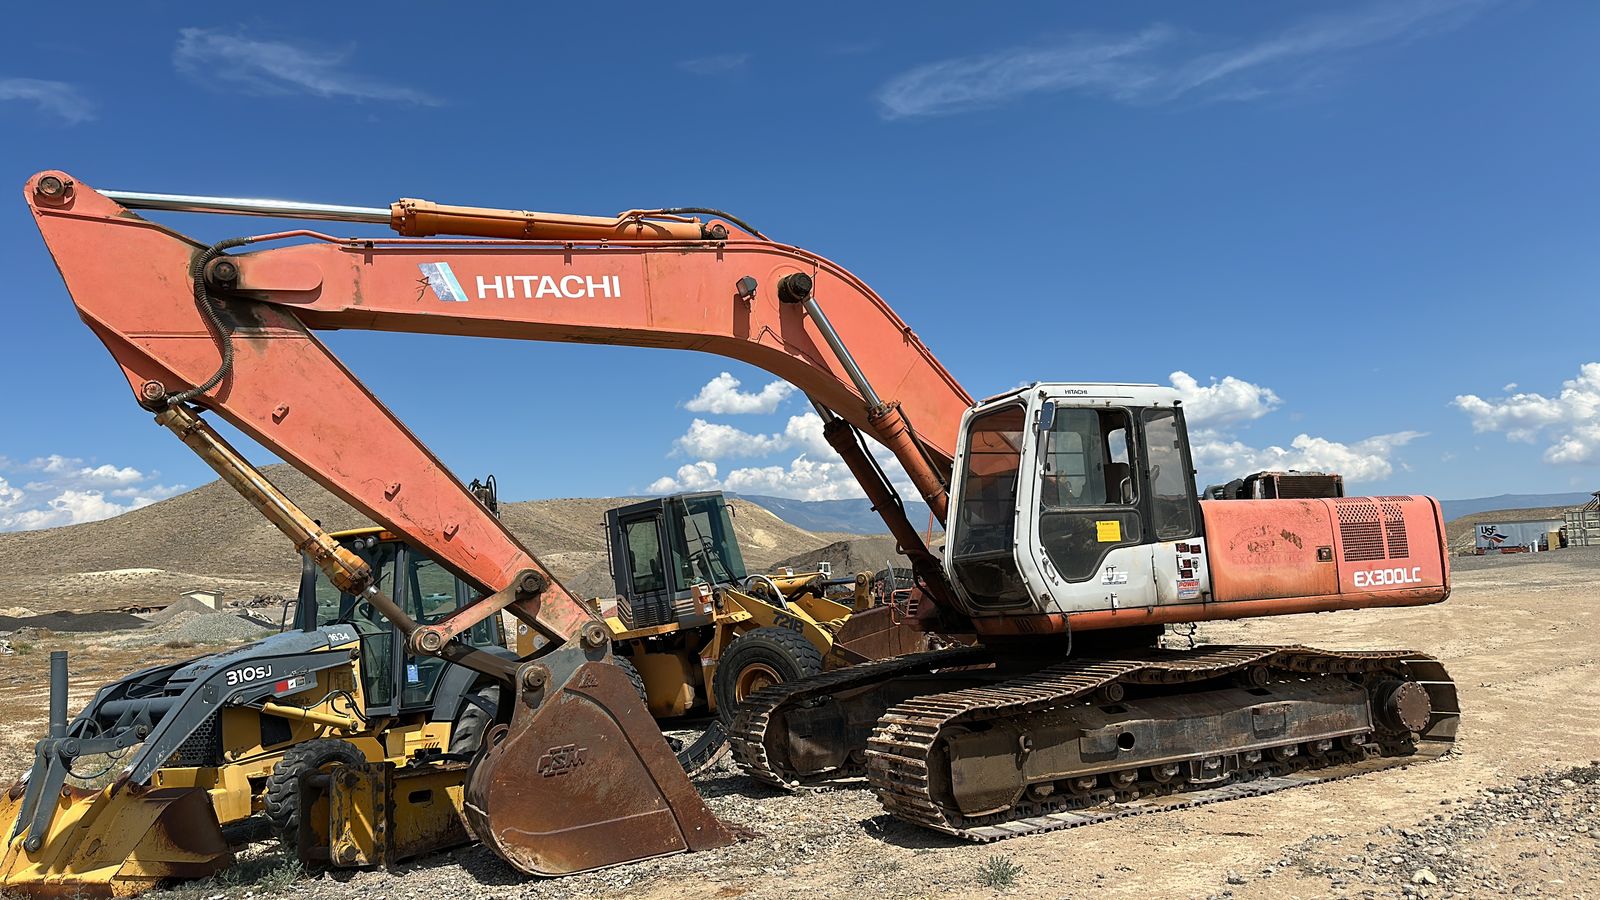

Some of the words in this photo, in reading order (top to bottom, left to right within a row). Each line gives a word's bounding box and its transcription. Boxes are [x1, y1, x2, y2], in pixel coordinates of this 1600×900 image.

[476, 275, 621, 299] HITACHI
[1481, 526, 1497, 536] USF
[1353, 566, 1422, 587] EX300LC
[773, 610, 804, 634] 721B
[328, 632, 350, 641] 1634
[226, 664, 272, 686] 310SJ
